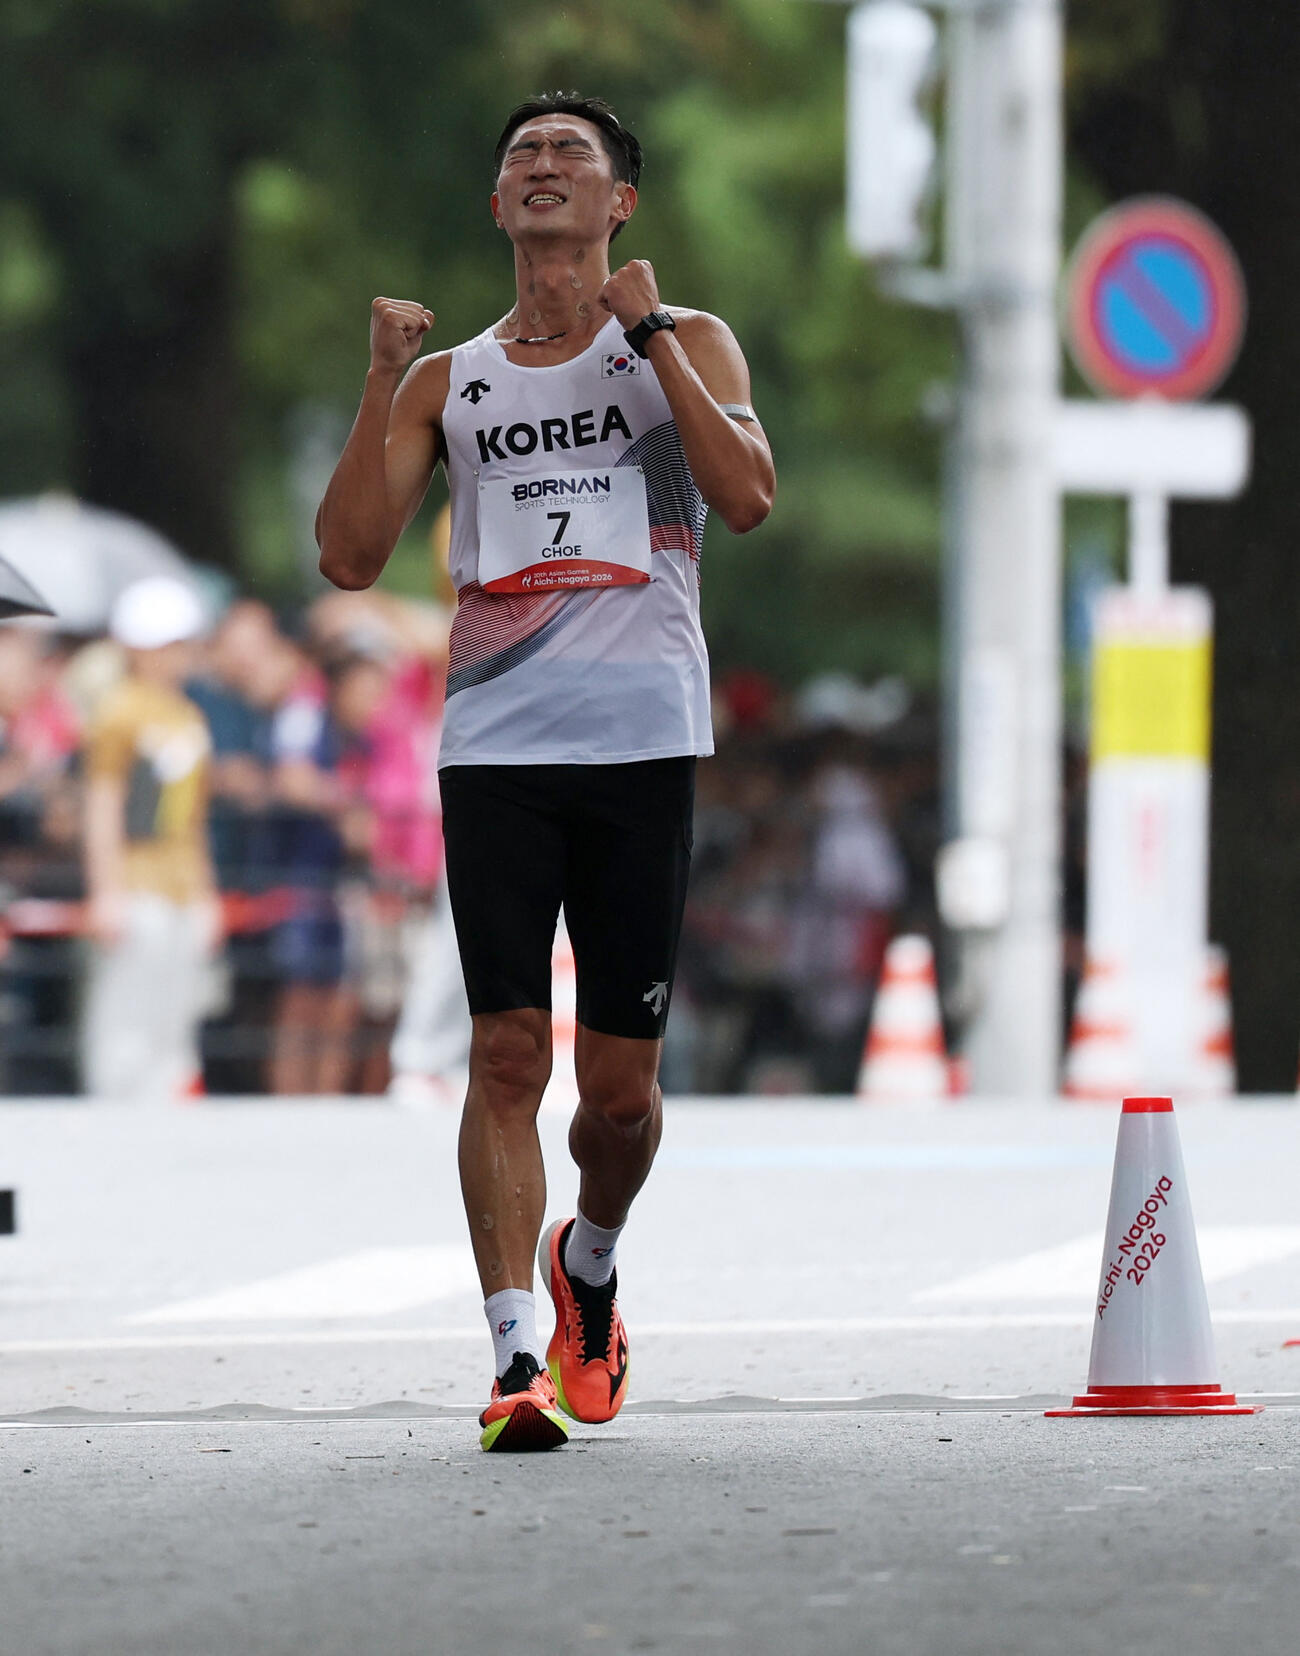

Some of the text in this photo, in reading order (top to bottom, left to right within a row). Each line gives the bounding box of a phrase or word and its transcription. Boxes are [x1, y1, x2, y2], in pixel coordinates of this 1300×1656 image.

[476, 405, 633, 463] KOREA
[511, 475, 611, 501] BORNAN
[514, 494, 611, 512] SPORTS TECHNOLOGY
[547, 511, 571, 545] 7
[541, 545, 582, 558] CHOE
[533, 573, 613, 586] Aichi-Nagoya 2026
[1097, 1175, 1173, 1320] Aichi-Nagoya
[1126, 1232, 1167, 1286] 2026
